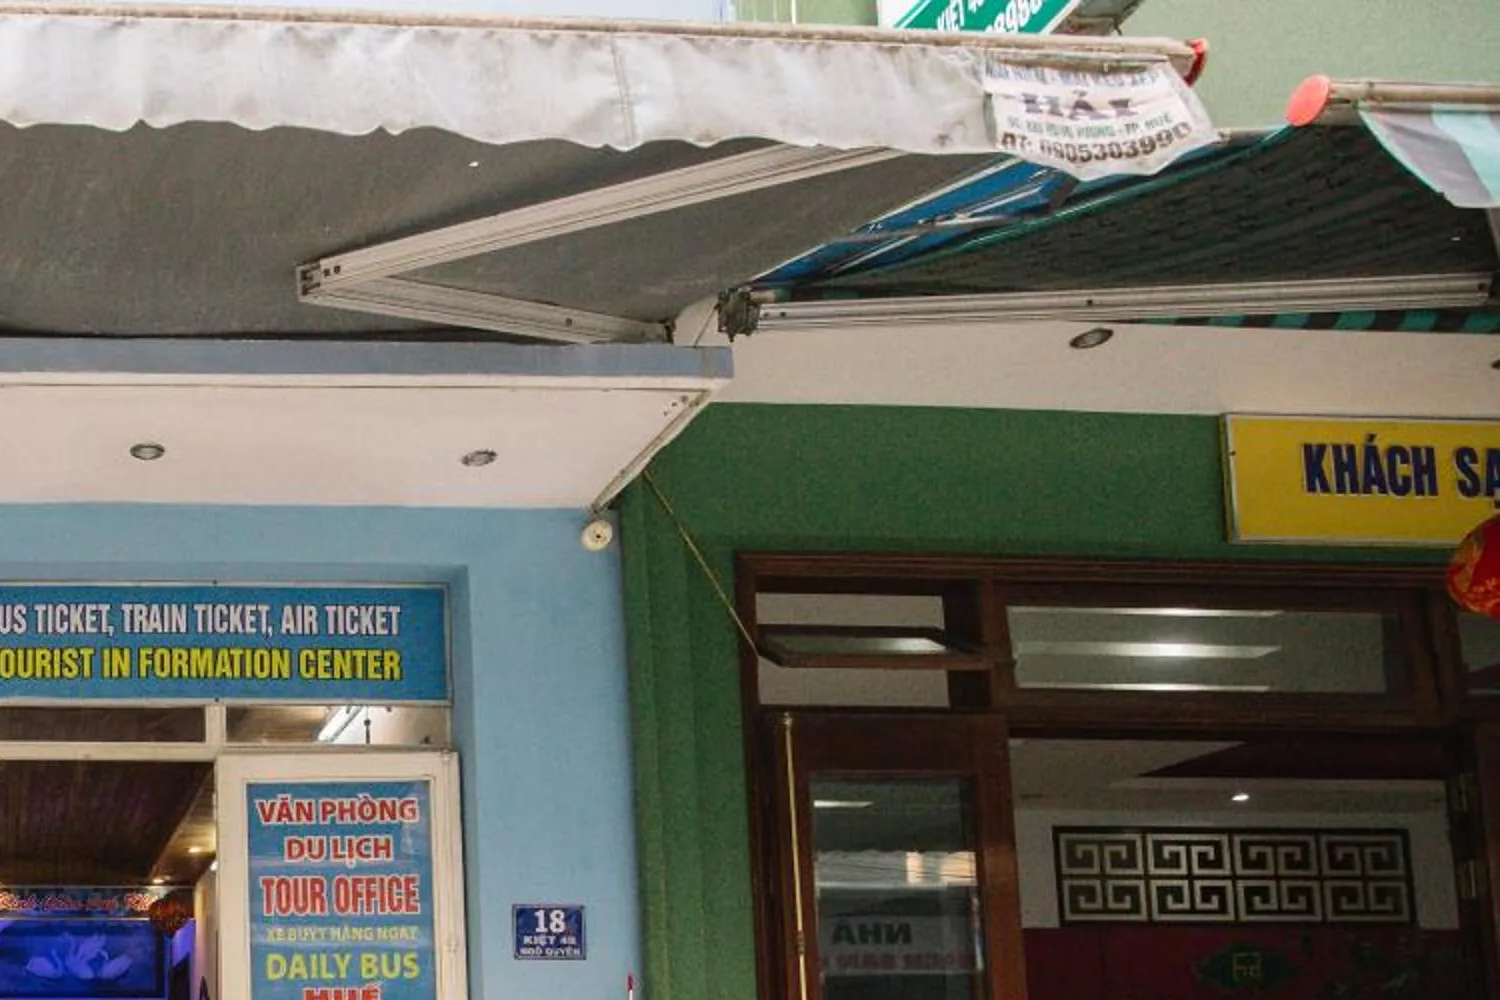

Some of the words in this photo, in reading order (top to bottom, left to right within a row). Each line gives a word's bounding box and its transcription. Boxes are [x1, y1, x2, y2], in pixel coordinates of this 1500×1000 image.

[1303, 433, 1439, 497] KHÁCH
[35, 604, 115, 637] TICKET,
[121, 604, 187, 635] TRAIN
[194, 604, 273, 638] TICKET,
[281, 605, 319, 635] AIR
[325, 605, 402, 636] TICKET
[103, 648, 132, 679] IN
[140, 648, 291, 679] FORMATION
[299, 648, 402, 680] CENTER
[257, 793, 315, 824] VĂN
[319, 792, 419, 824] PHÒNG
[285, 835, 327, 862] DU
[331, 835, 393, 868] LỊCH
[260, 875, 328, 916] TOUR
[333, 875, 421, 915] OFFICE
[533, 909, 566, 933] 18
[266, 951, 352, 981] DAILY
[360, 951, 420, 980] BUS
